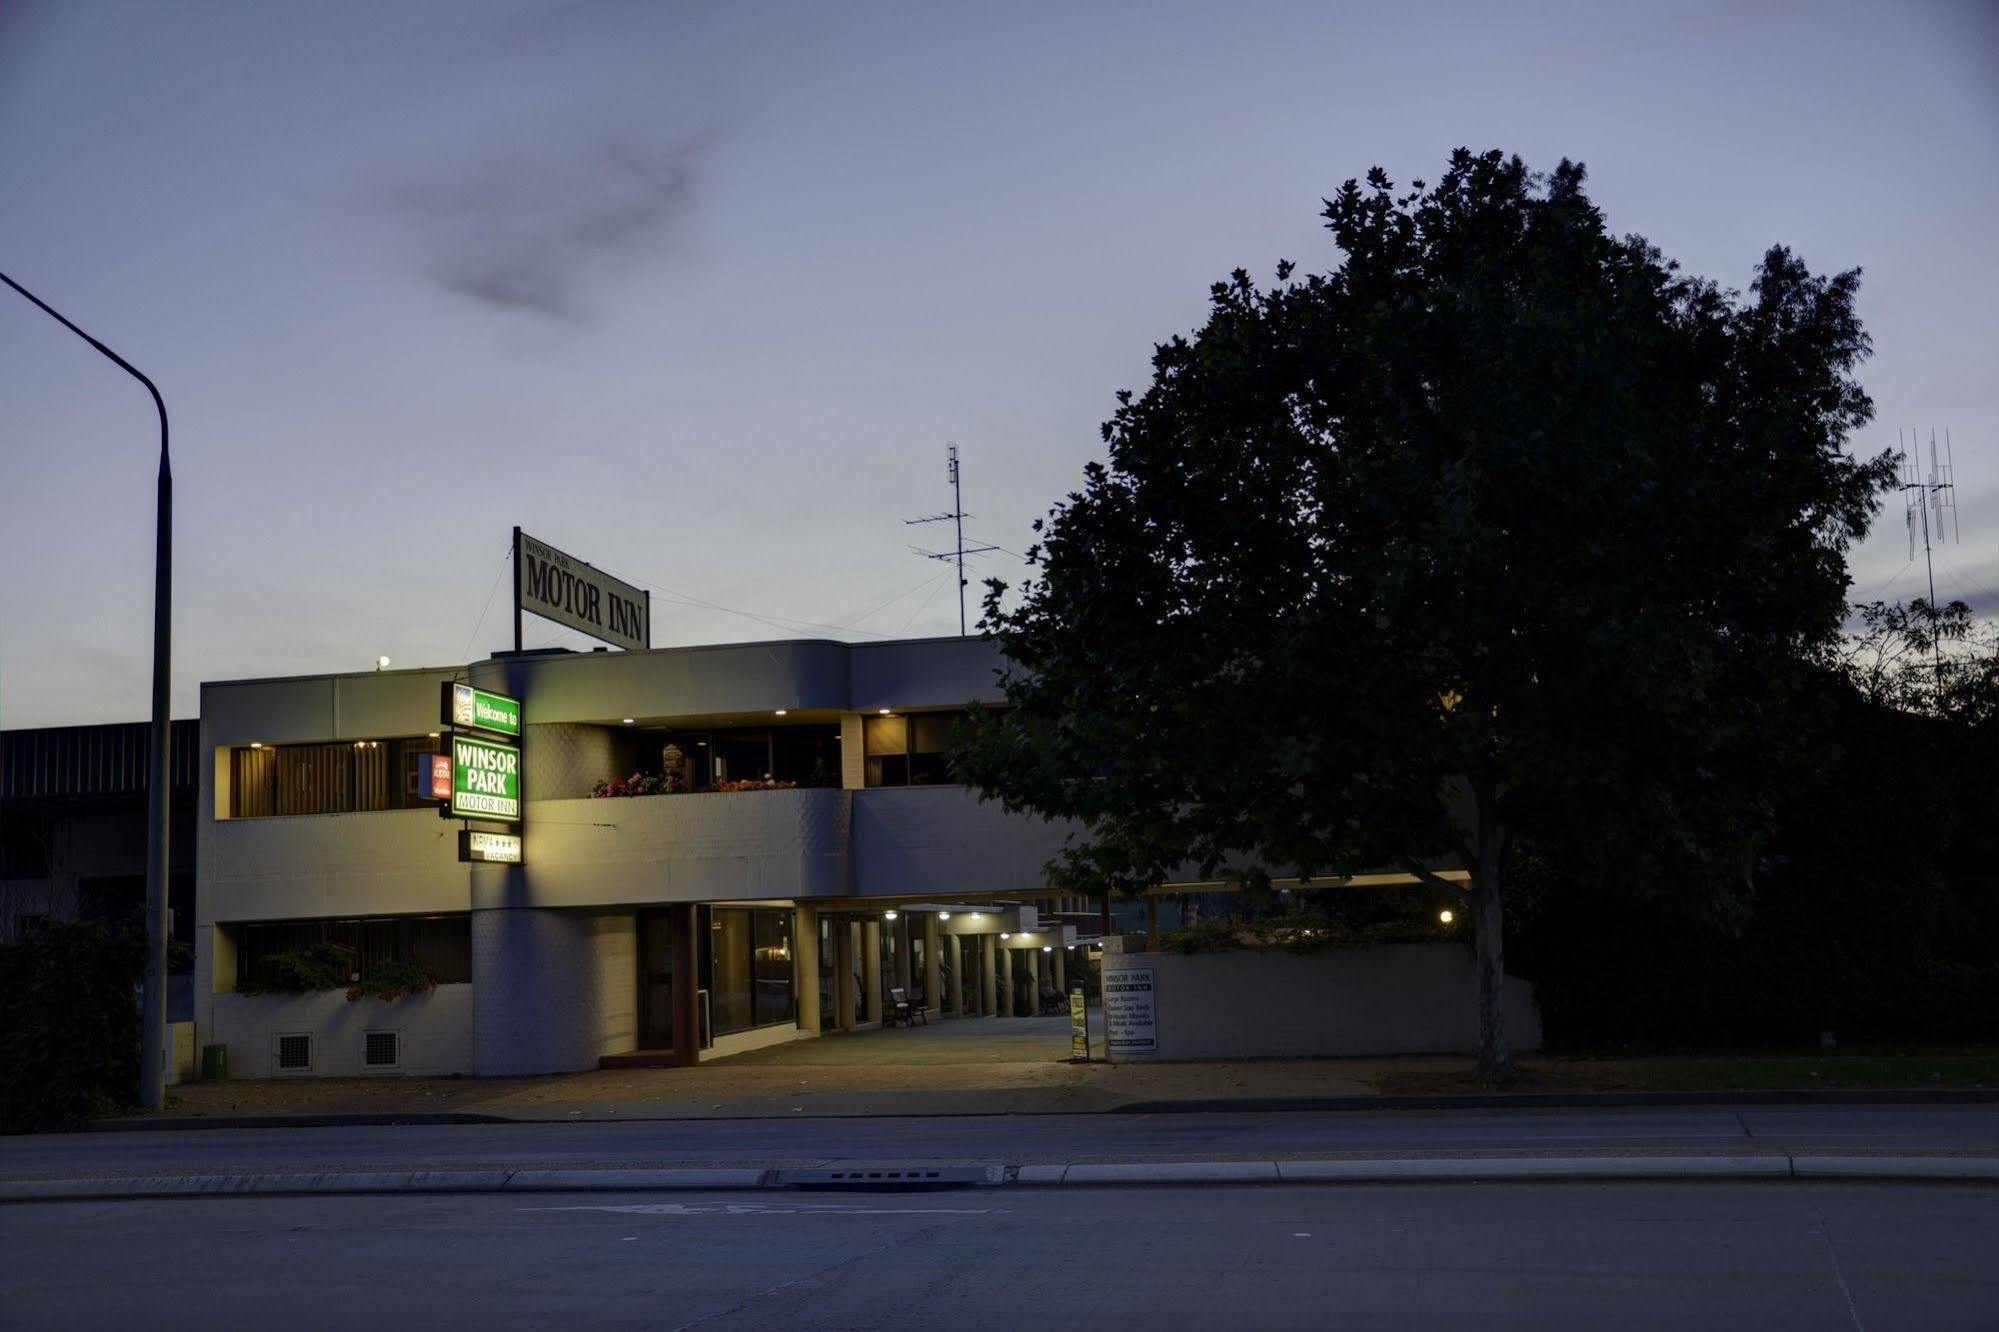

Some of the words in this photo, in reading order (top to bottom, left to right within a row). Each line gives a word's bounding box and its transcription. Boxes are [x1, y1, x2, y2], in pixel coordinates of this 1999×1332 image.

[526, 554, 601, 626] MOTOR
[608, 591, 643, 641] INN
[476, 702, 508, 723] Welcome
[509, 712, 517, 726] to
[457, 743, 516, 774] WINSOR
[467, 768, 507, 795] PARK
[459, 793, 495, 810] MOTOR
[497, 799, 515, 813] INN
[485, 852, 518, 861] VACANCY
[1131, 973, 1152, 982] PARK
